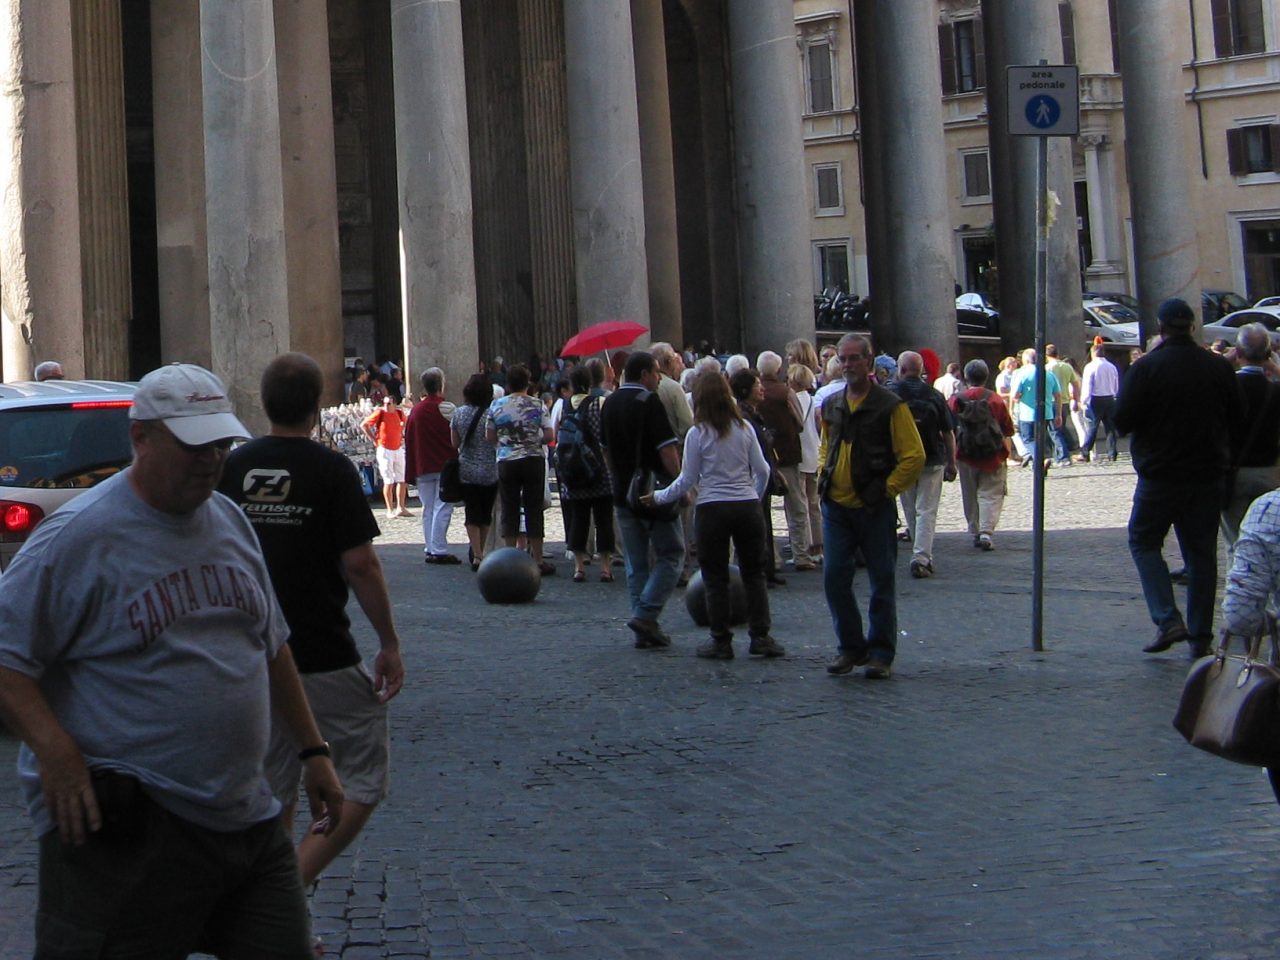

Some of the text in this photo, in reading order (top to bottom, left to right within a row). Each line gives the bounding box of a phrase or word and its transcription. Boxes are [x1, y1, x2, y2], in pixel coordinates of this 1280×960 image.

[1031, 71, 1053, 79] area
[1019, 80, 1066, 90] pedonale
[127, 568, 201, 653] SANTA
